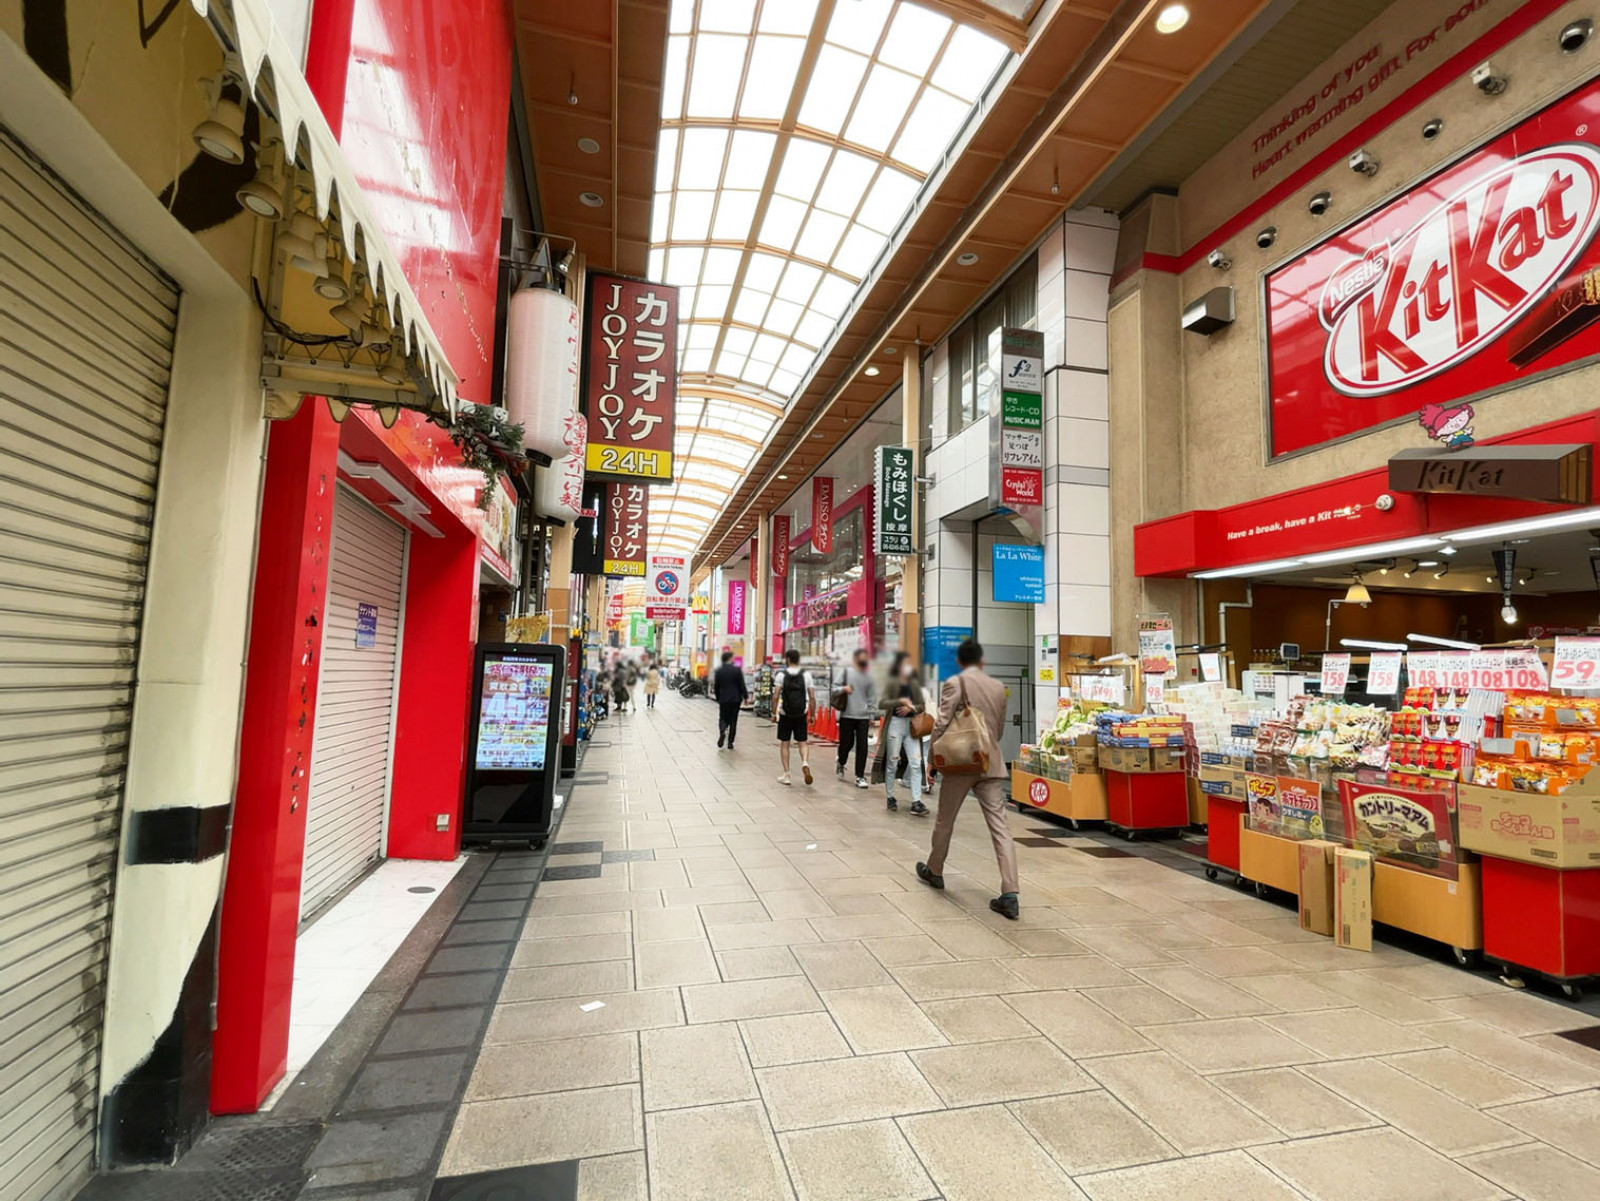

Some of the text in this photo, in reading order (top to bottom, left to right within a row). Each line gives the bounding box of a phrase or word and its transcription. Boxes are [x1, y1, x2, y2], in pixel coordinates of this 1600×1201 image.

[1252, 95, 1317, 152] Thinking
[599, 284, 628, 441] JOYJOY
[628, 291, 670, 442] カラオケ
[601, 447, 657, 475] 24H
[892, 453, 908, 521] もみほぐし
[820, 484, 830, 522] DAISO
[610, 483, 625, 558] JOYJOY
[624, 485, 644, 558] カラオケ
[1227, 531, 1247, 541] Have
[1249, 528, 1255, 536] a
[1256, 522, 1283, 535] break,
[1284, 516, 1307, 529] have
[1308, 515, 1315, 523] a
[778, 521, 787, 552] DAISO
[611, 562, 639, 574] 24H
[1323, 671, 1344, 687] 158
[1370, 671, 1393, 686] 158
[1409, 669, 1437, 688] 148
[1471, 669, 1503, 687] 108
[1505, 669, 1540, 688] 108
[1555, 660, 1595, 680] 59
